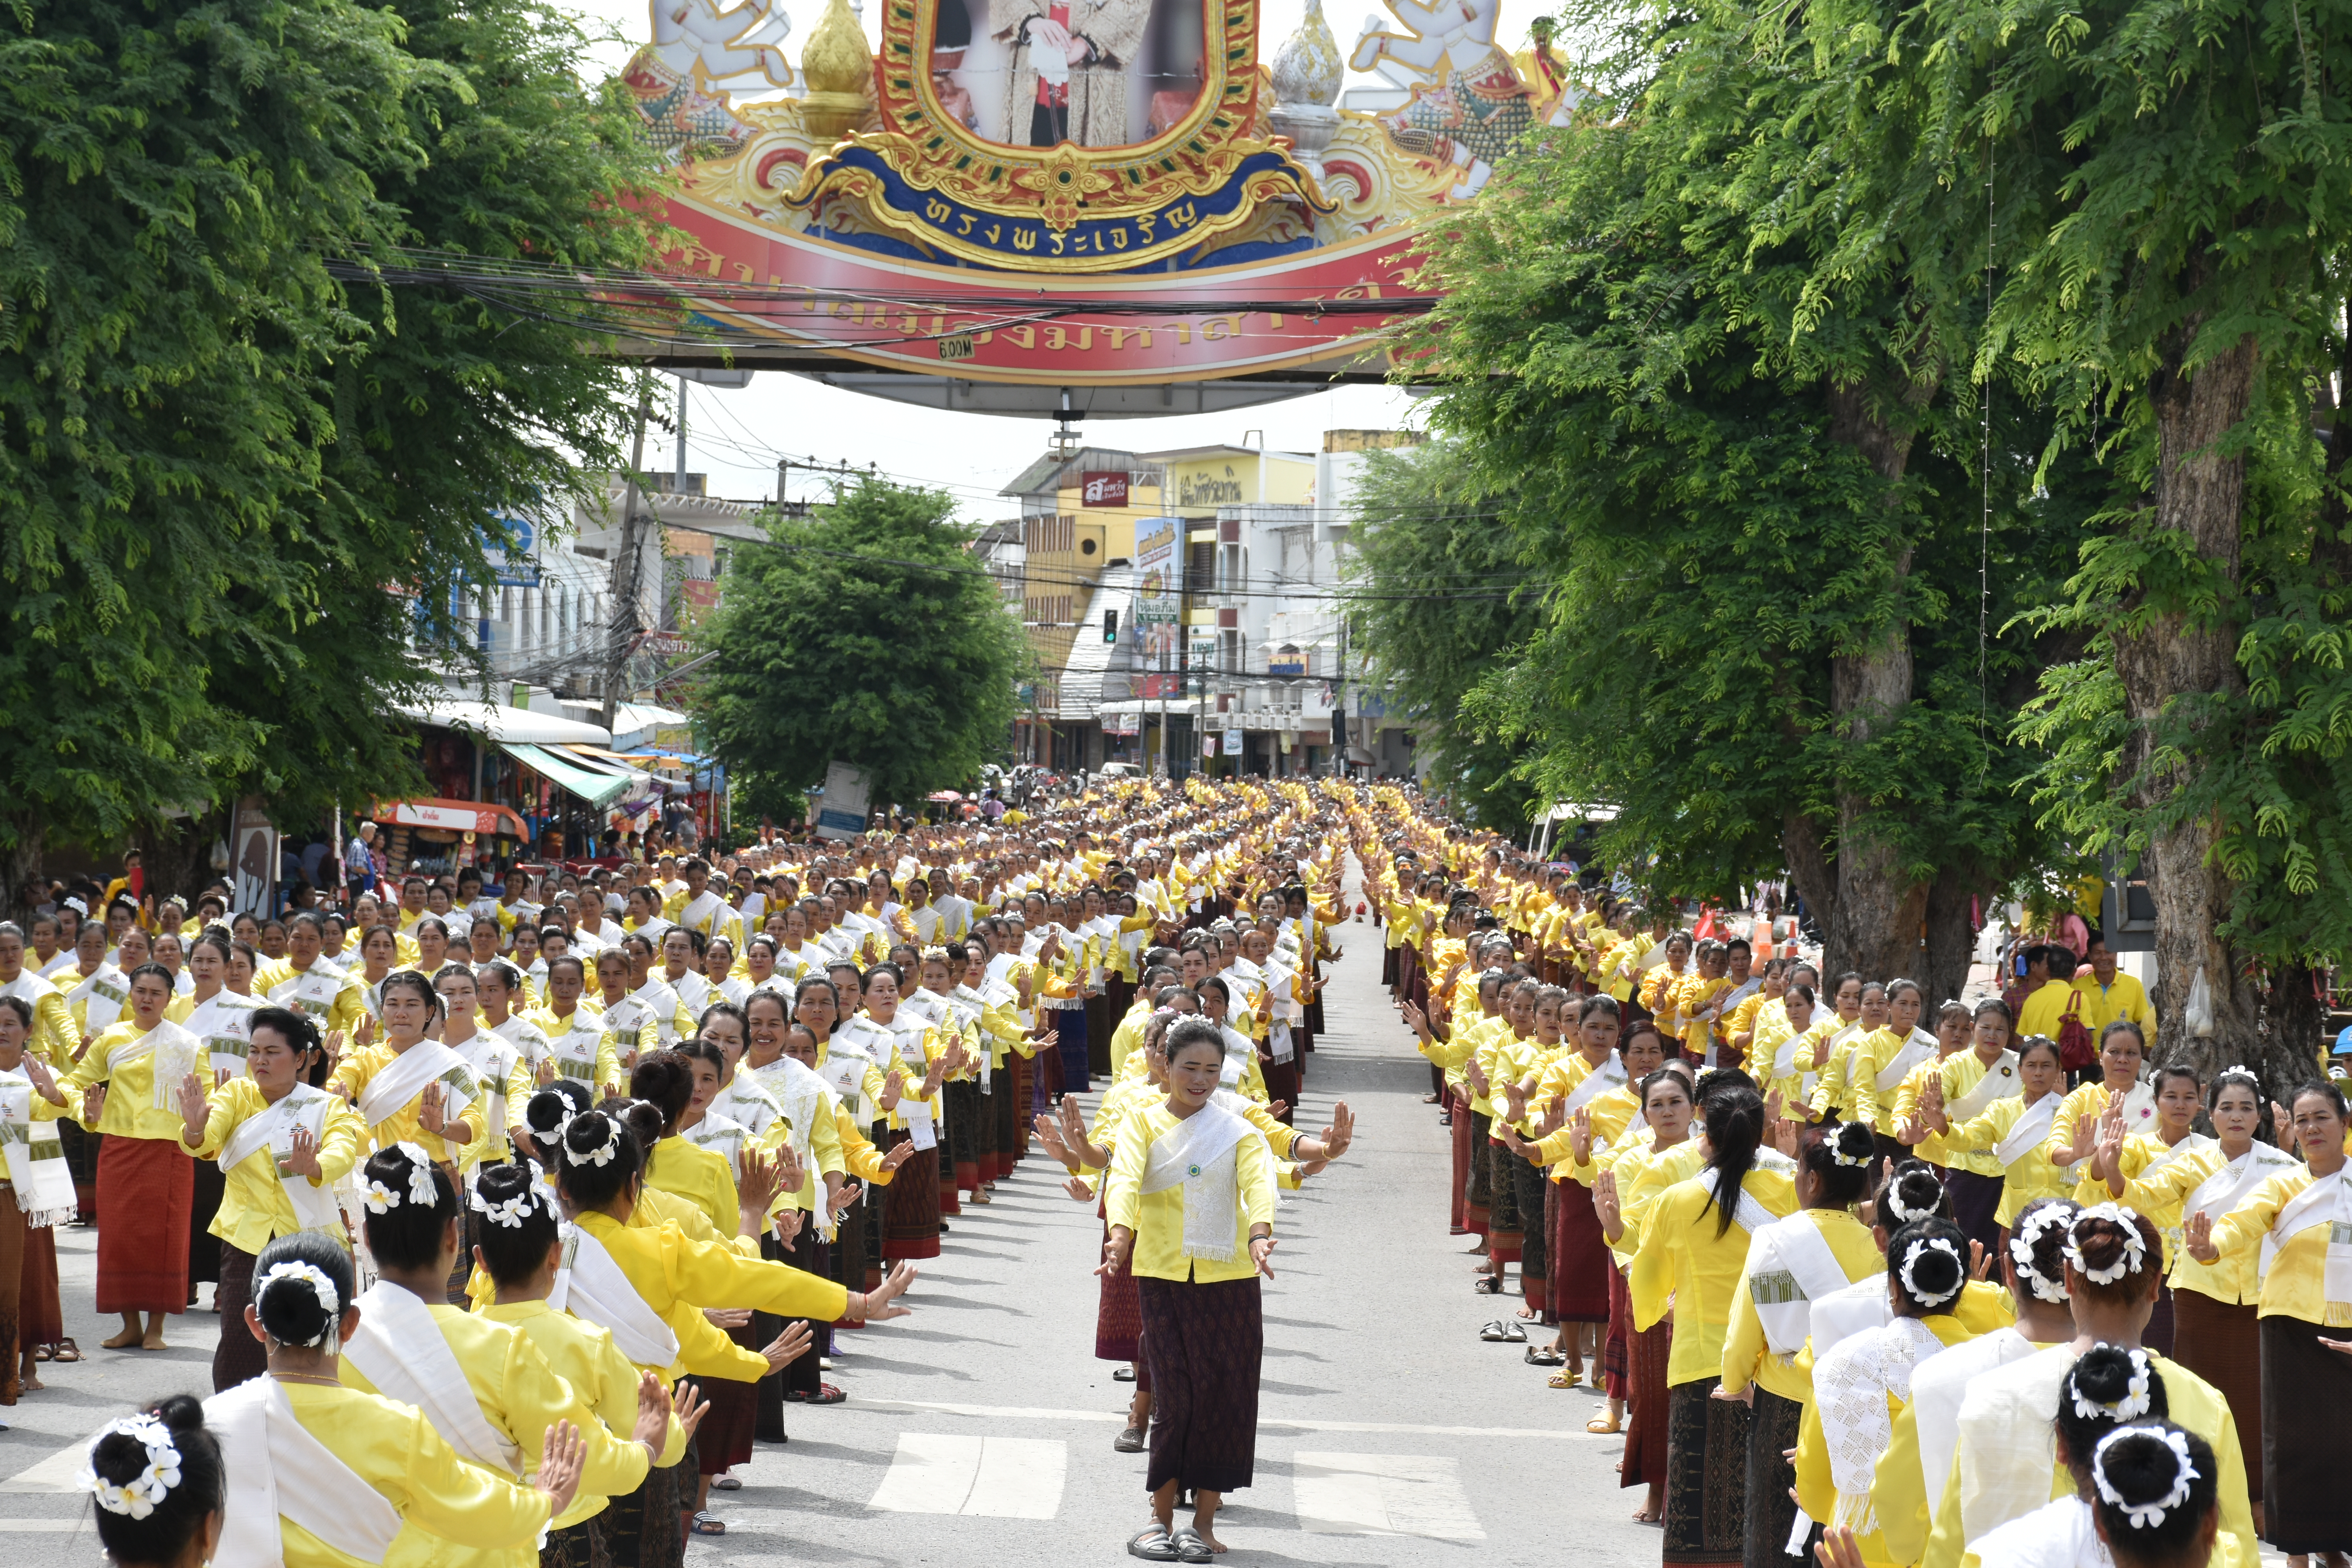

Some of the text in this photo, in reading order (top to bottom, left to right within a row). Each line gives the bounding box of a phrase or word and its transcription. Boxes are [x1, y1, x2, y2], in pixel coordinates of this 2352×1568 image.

[926, 197, 1197, 256] ทรงพระเจริญ
[1085, 477, 1125, 503] สมหวัง
